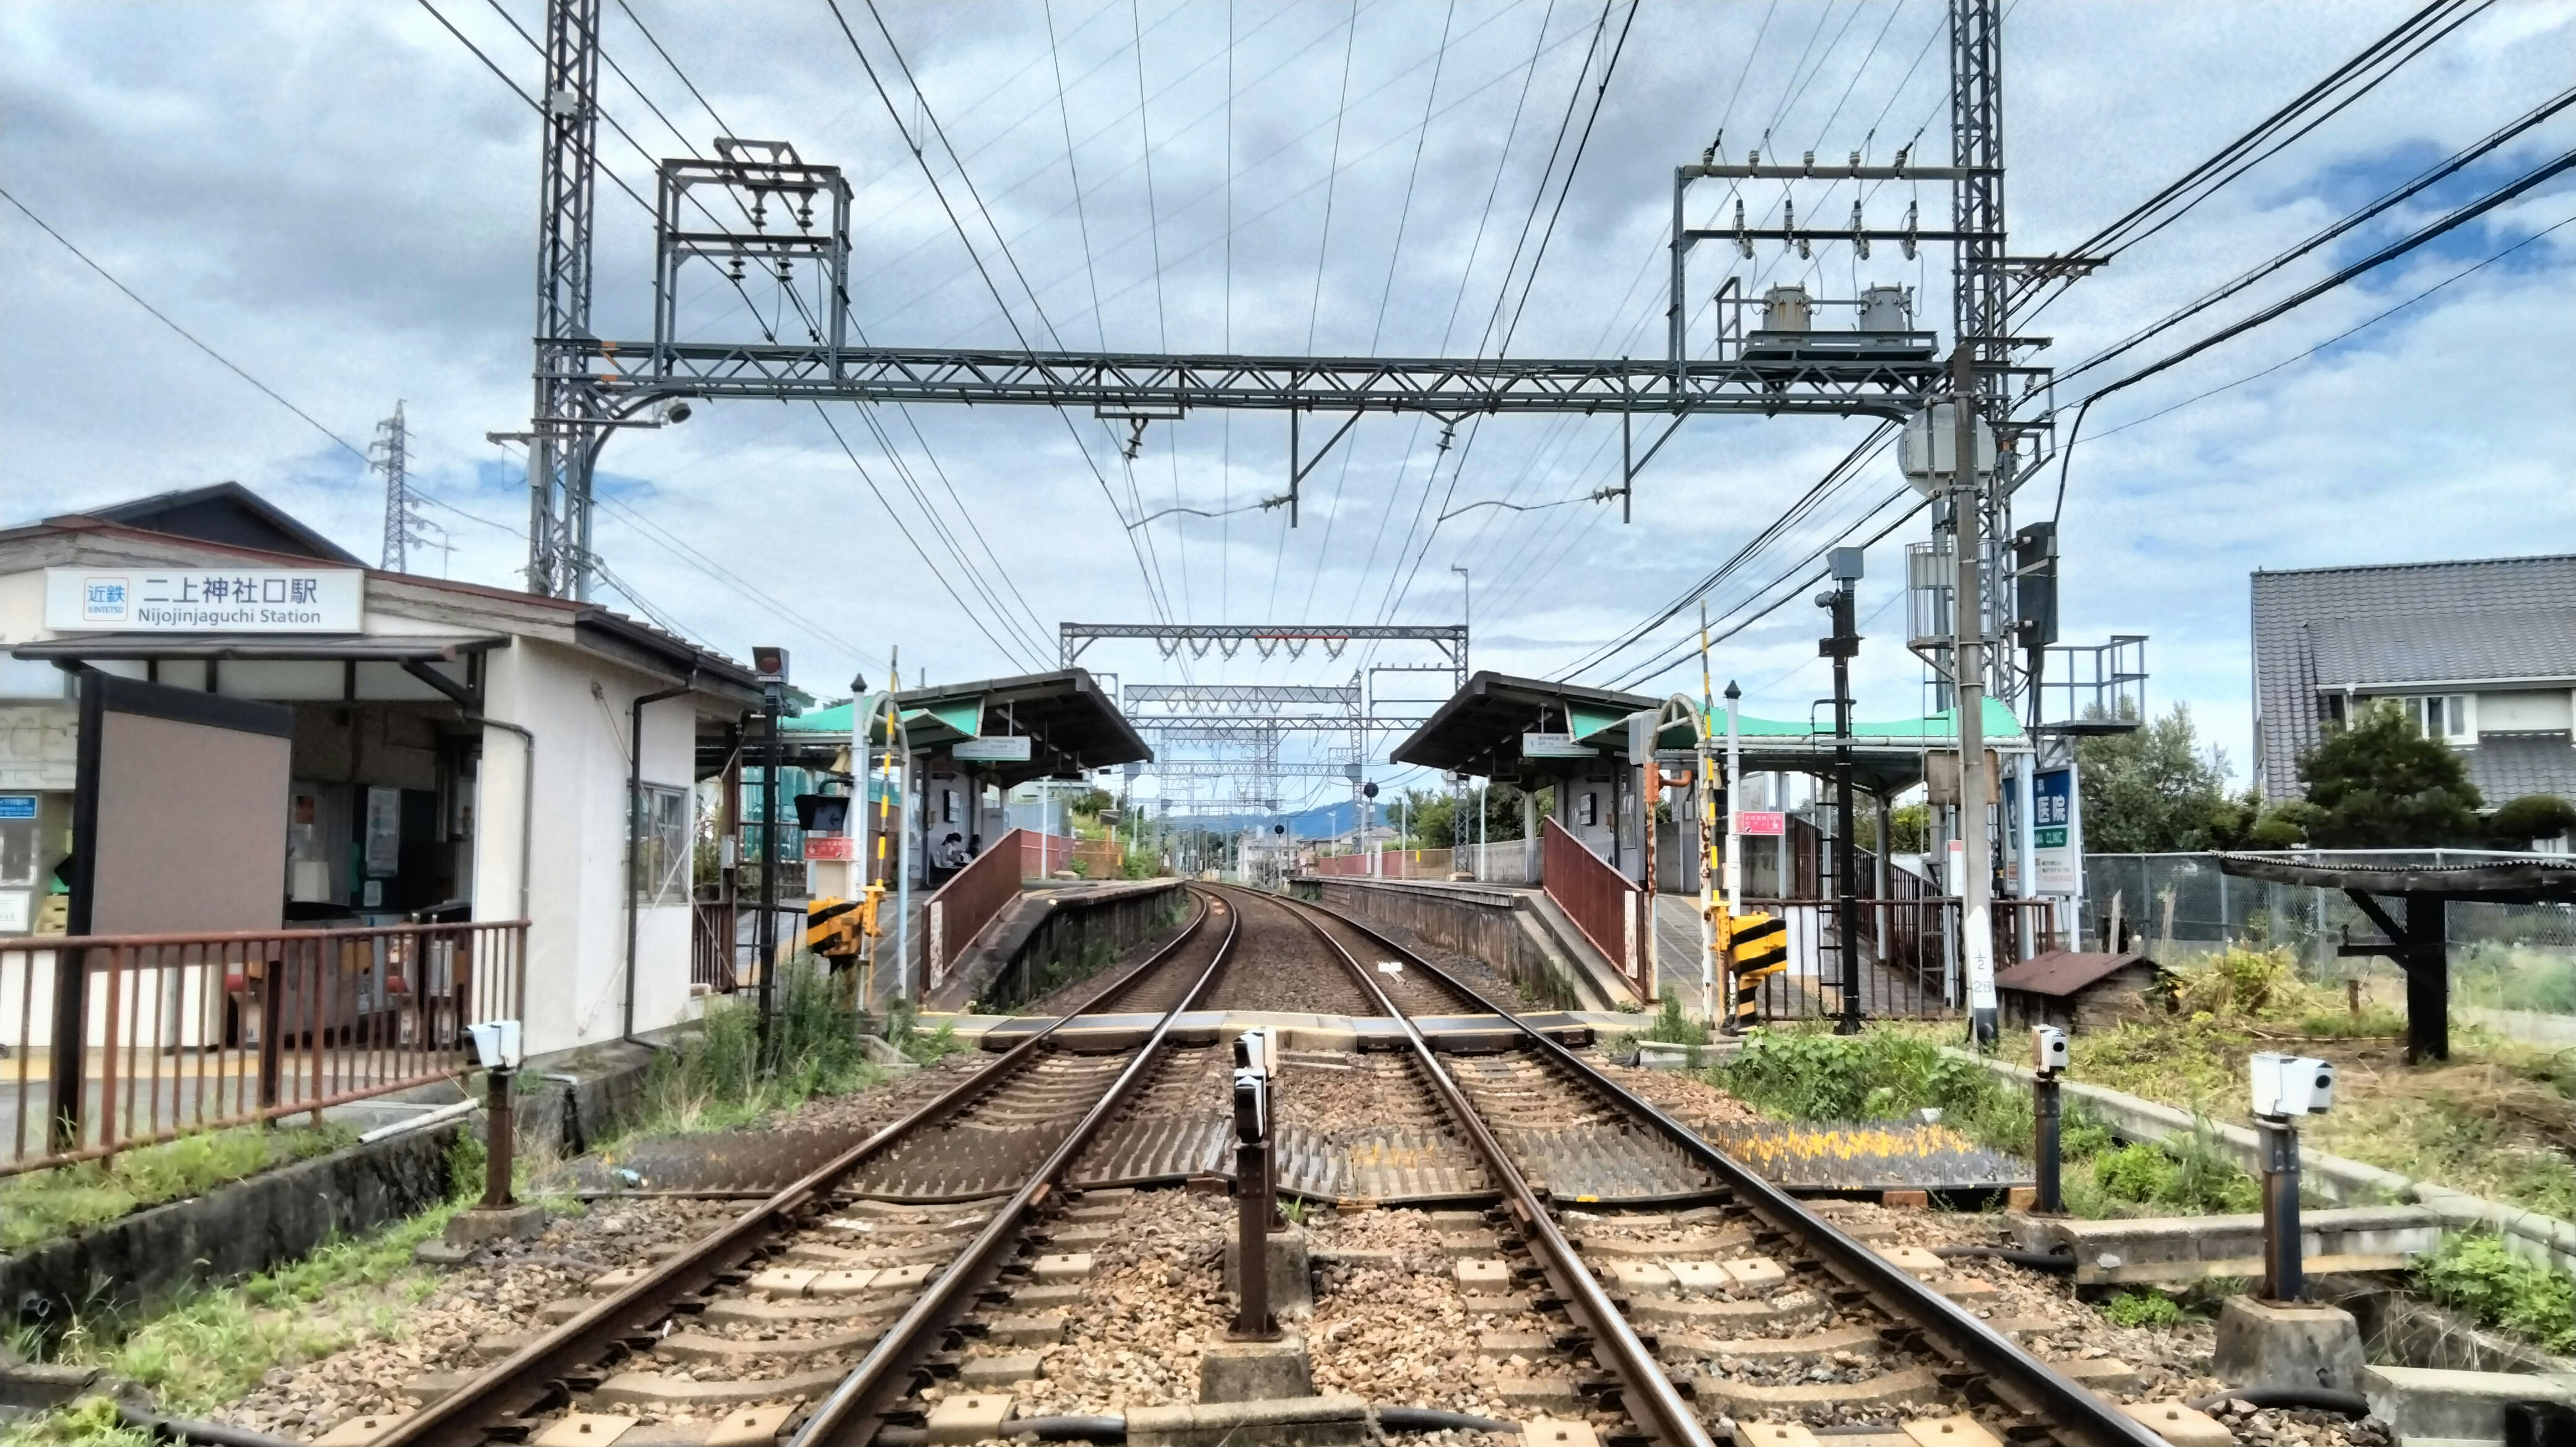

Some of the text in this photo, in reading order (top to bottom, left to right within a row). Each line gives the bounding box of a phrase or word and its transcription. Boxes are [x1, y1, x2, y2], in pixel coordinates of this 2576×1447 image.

[88, 585, 125, 603] 近鉄
[143, 577, 318, 604] 二上神社口駅
[138, 608, 321, 626] Nijojinjaguchi Station
[2037, 794, 2066, 823] 医院
